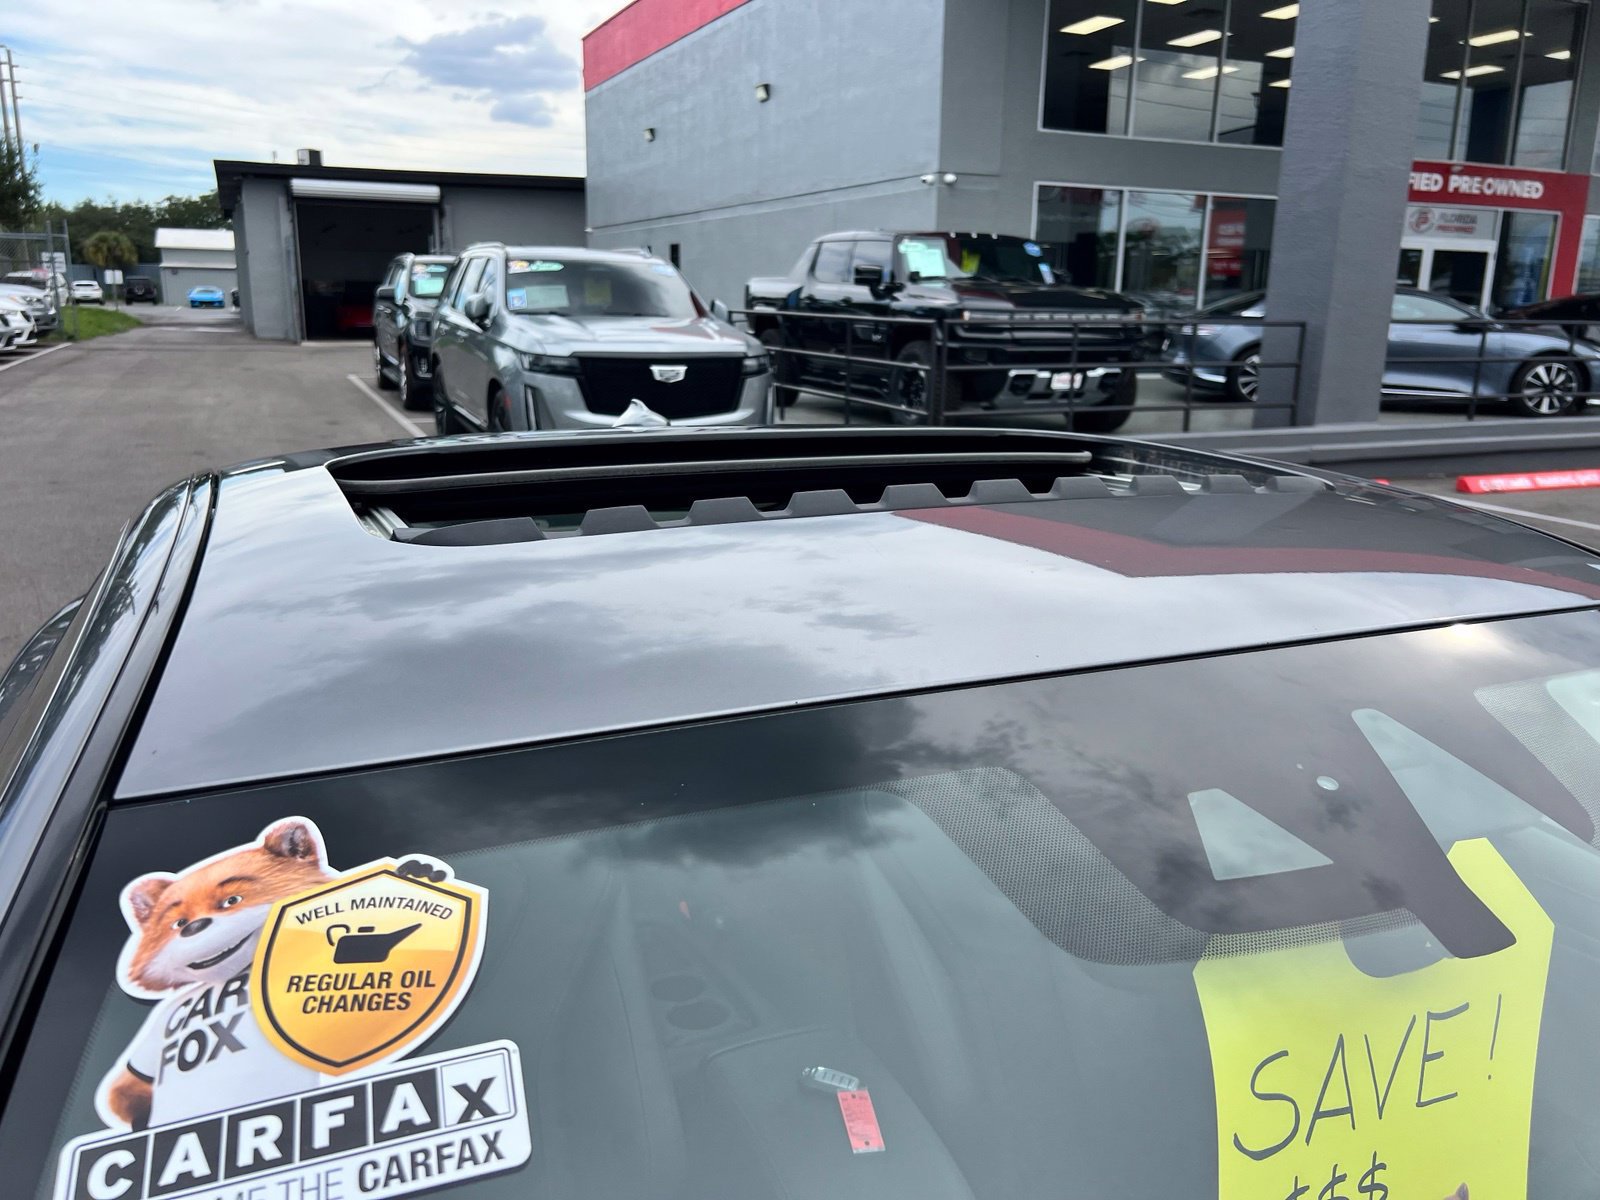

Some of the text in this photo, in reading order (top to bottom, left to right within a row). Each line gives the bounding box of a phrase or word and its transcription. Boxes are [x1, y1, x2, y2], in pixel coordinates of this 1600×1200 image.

[295, 896, 453, 925] WELL MAINTAINED
[164, 971, 249, 1040] CAR
[286, 970, 436, 993] REGULAR OIL
[302, 992, 412, 1014] CHANGES
[158, 1010, 248, 1086] FOX
[86, 1075, 500, 1200] CARFAX
[358, 1129, 505, 1193] CARFAX
